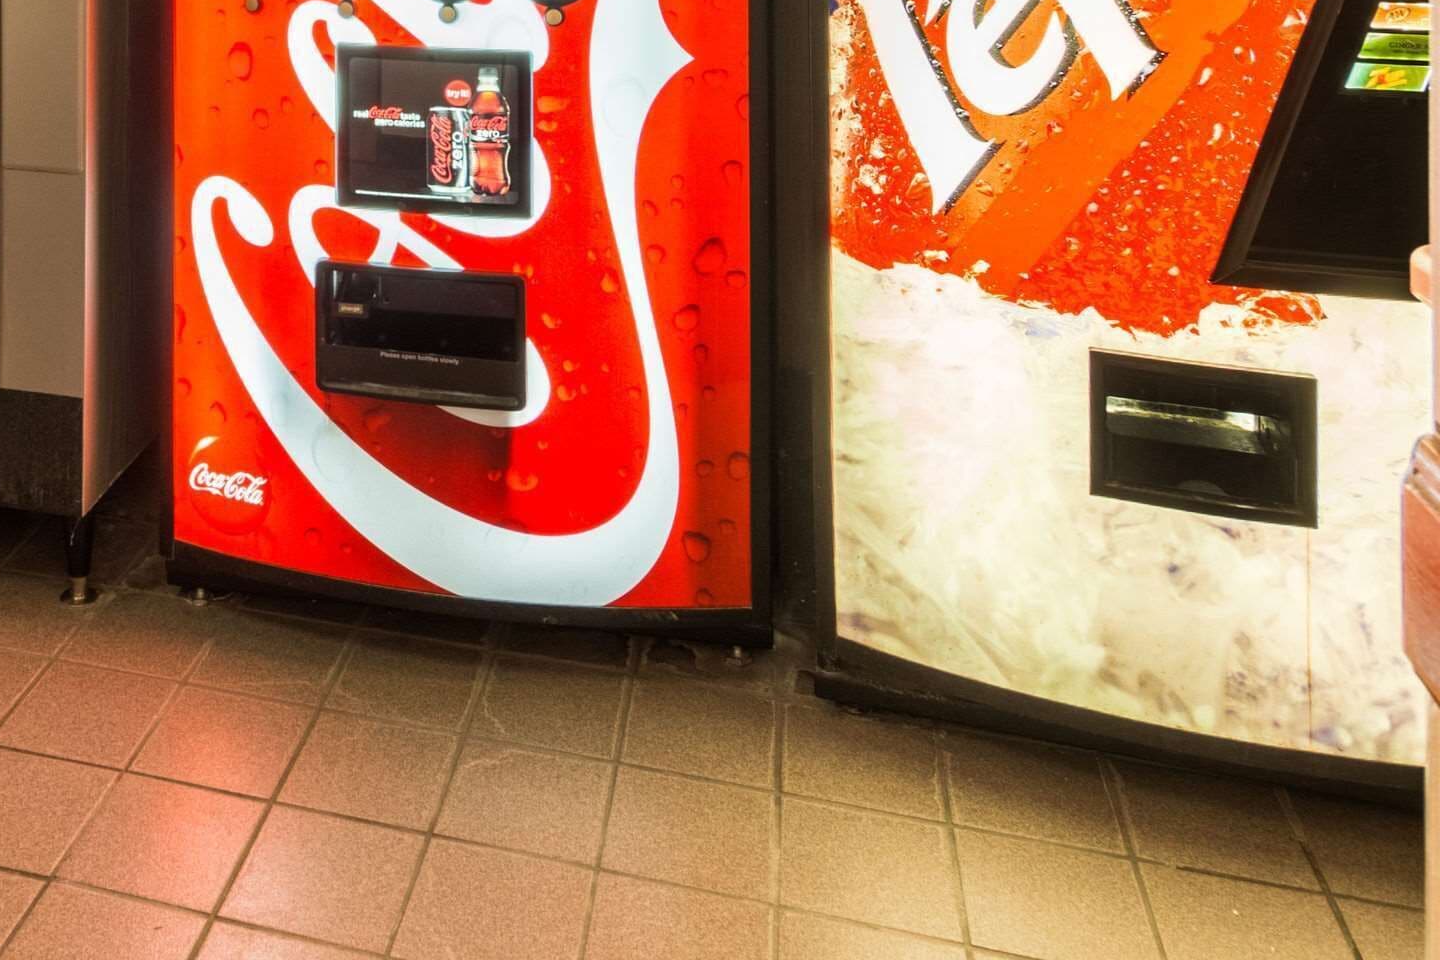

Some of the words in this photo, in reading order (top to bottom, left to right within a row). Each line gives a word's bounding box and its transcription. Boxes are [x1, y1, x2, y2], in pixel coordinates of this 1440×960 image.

[452, 131, 464, 170] zero
[475, 129, 500, 140] zero
[188, 462, 268, 507] Coca-Cola
